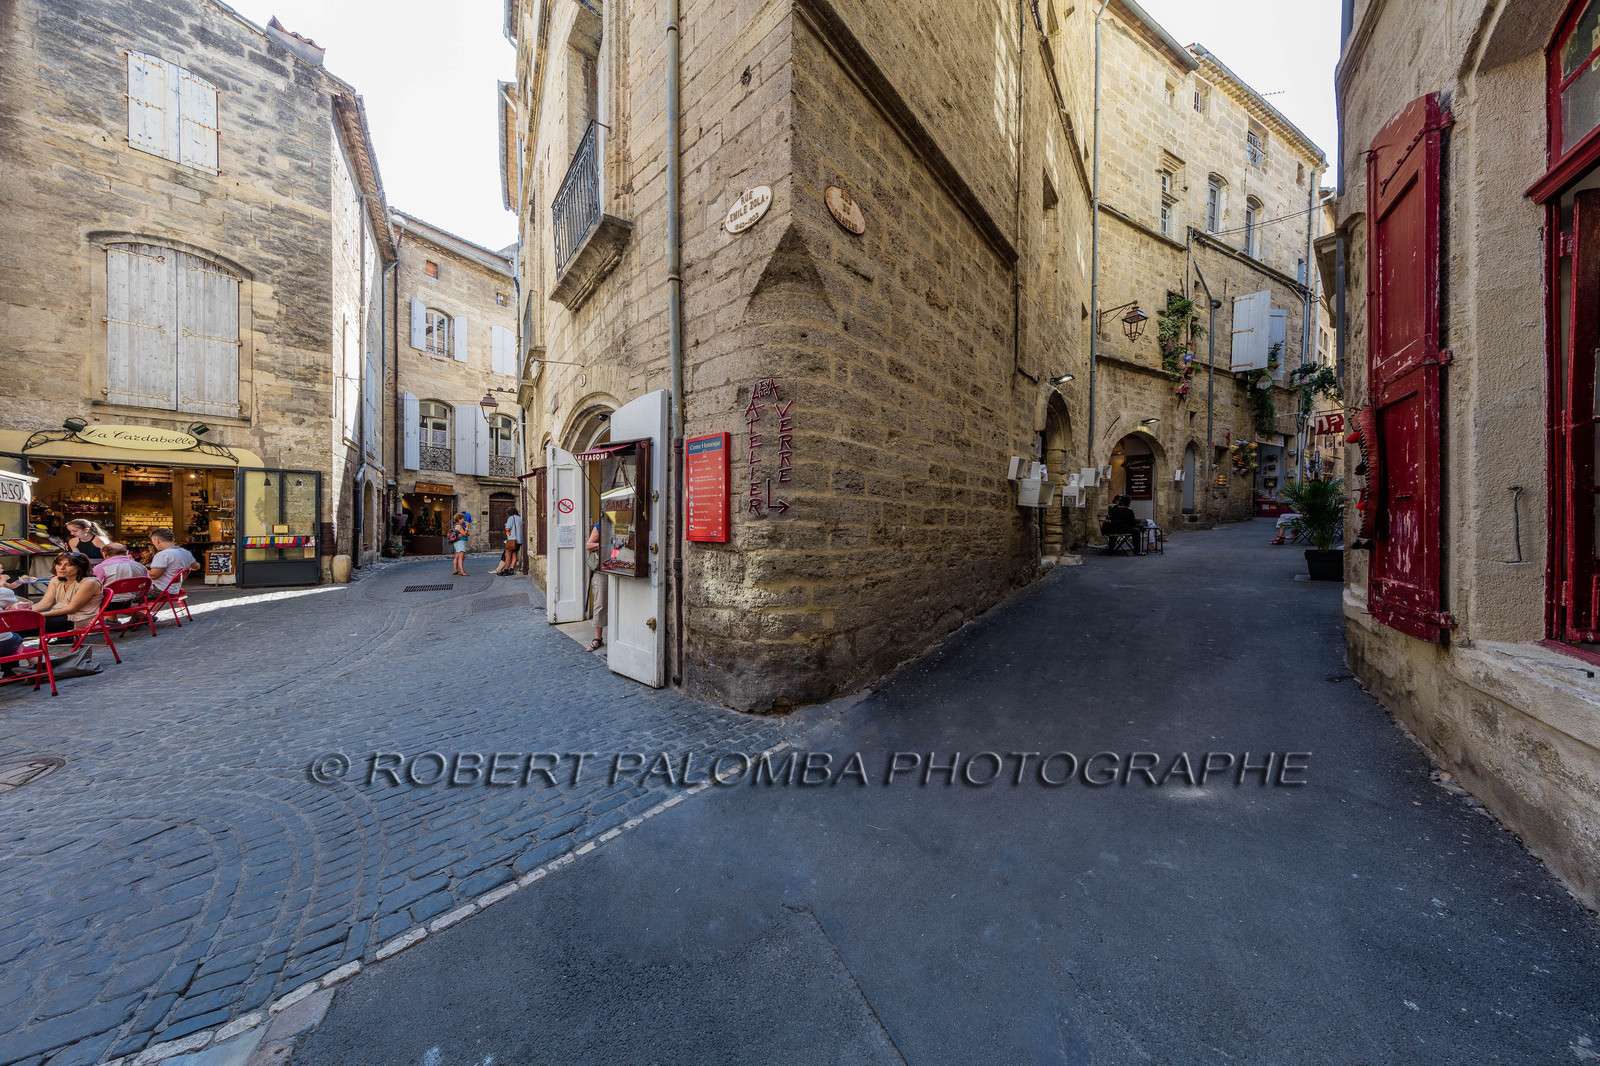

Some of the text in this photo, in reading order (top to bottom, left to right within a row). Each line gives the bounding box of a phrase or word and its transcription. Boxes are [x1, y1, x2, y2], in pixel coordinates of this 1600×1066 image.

[729, 194, 766, 223] EMILE ZOLA
[740, 190, 754, 206] RUE
[83, 428, 195, 445] La Cardabelle
[701, 440, 721, 449] Historique
[773, 400, 793, 483] VERRE
[744, 400, 764, 516] ATELIER
